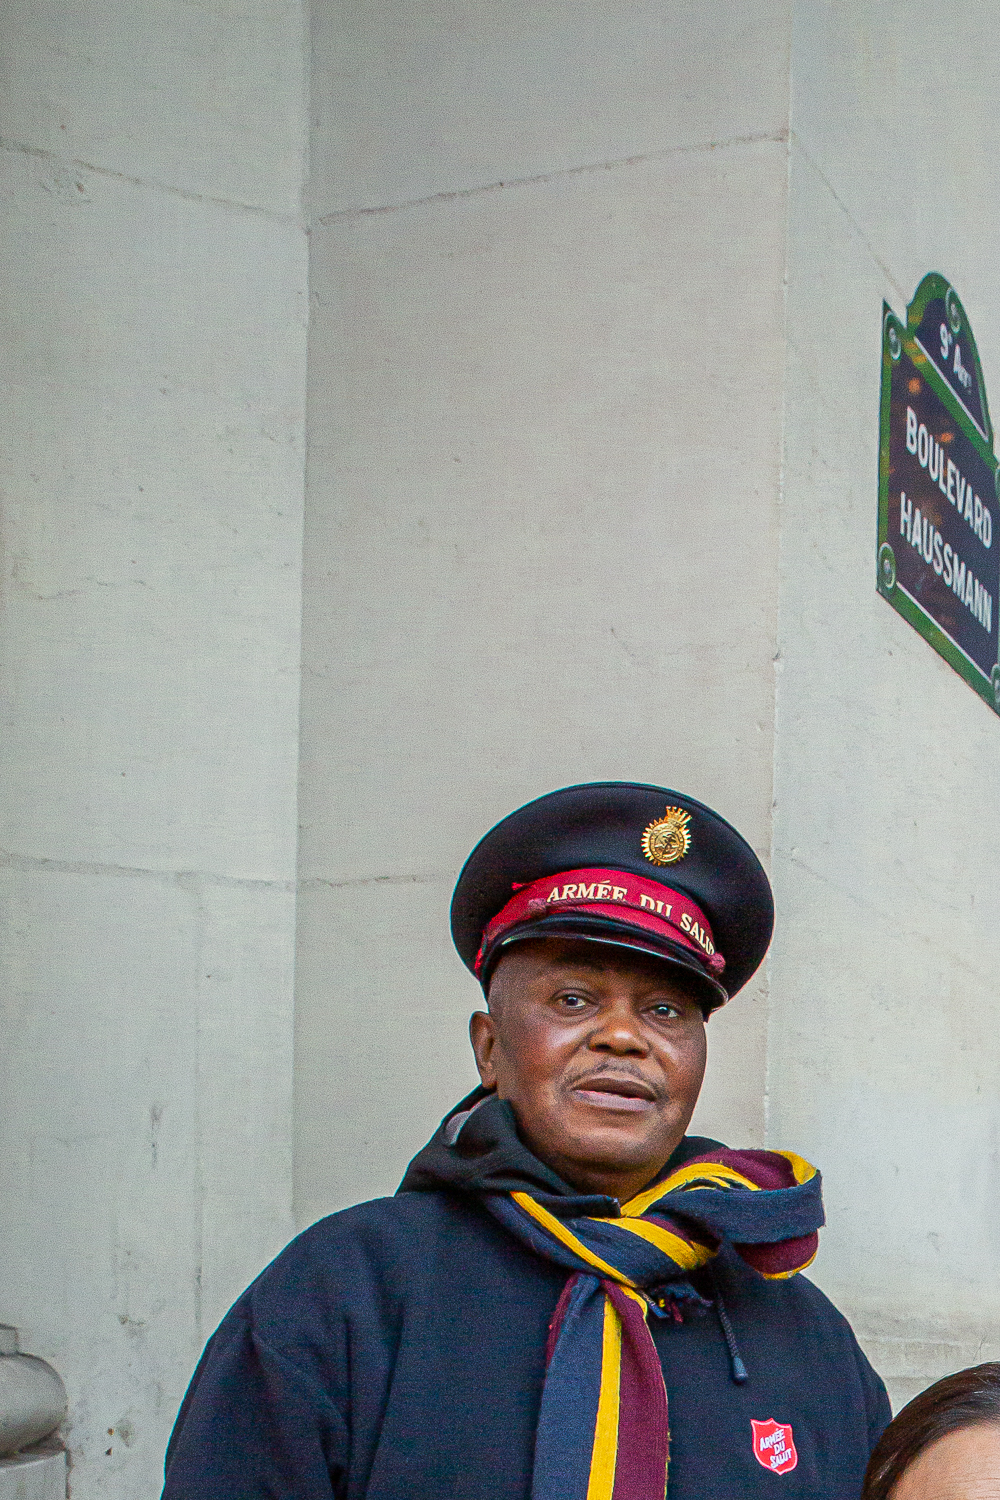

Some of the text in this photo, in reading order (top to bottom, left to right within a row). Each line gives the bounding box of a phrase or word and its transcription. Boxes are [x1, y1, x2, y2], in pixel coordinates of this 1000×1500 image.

[906, 406, 992, 549] BOULEVARD
[900, 491, 991, 633] HAUSSMANN
[547, 880, 628, 902] ARMÉE
[760, 1428, 786, 1452] ARMÉE
[773, 1440, 786, 1456] DU
[770, 1447, 792, 1469] SALUT
